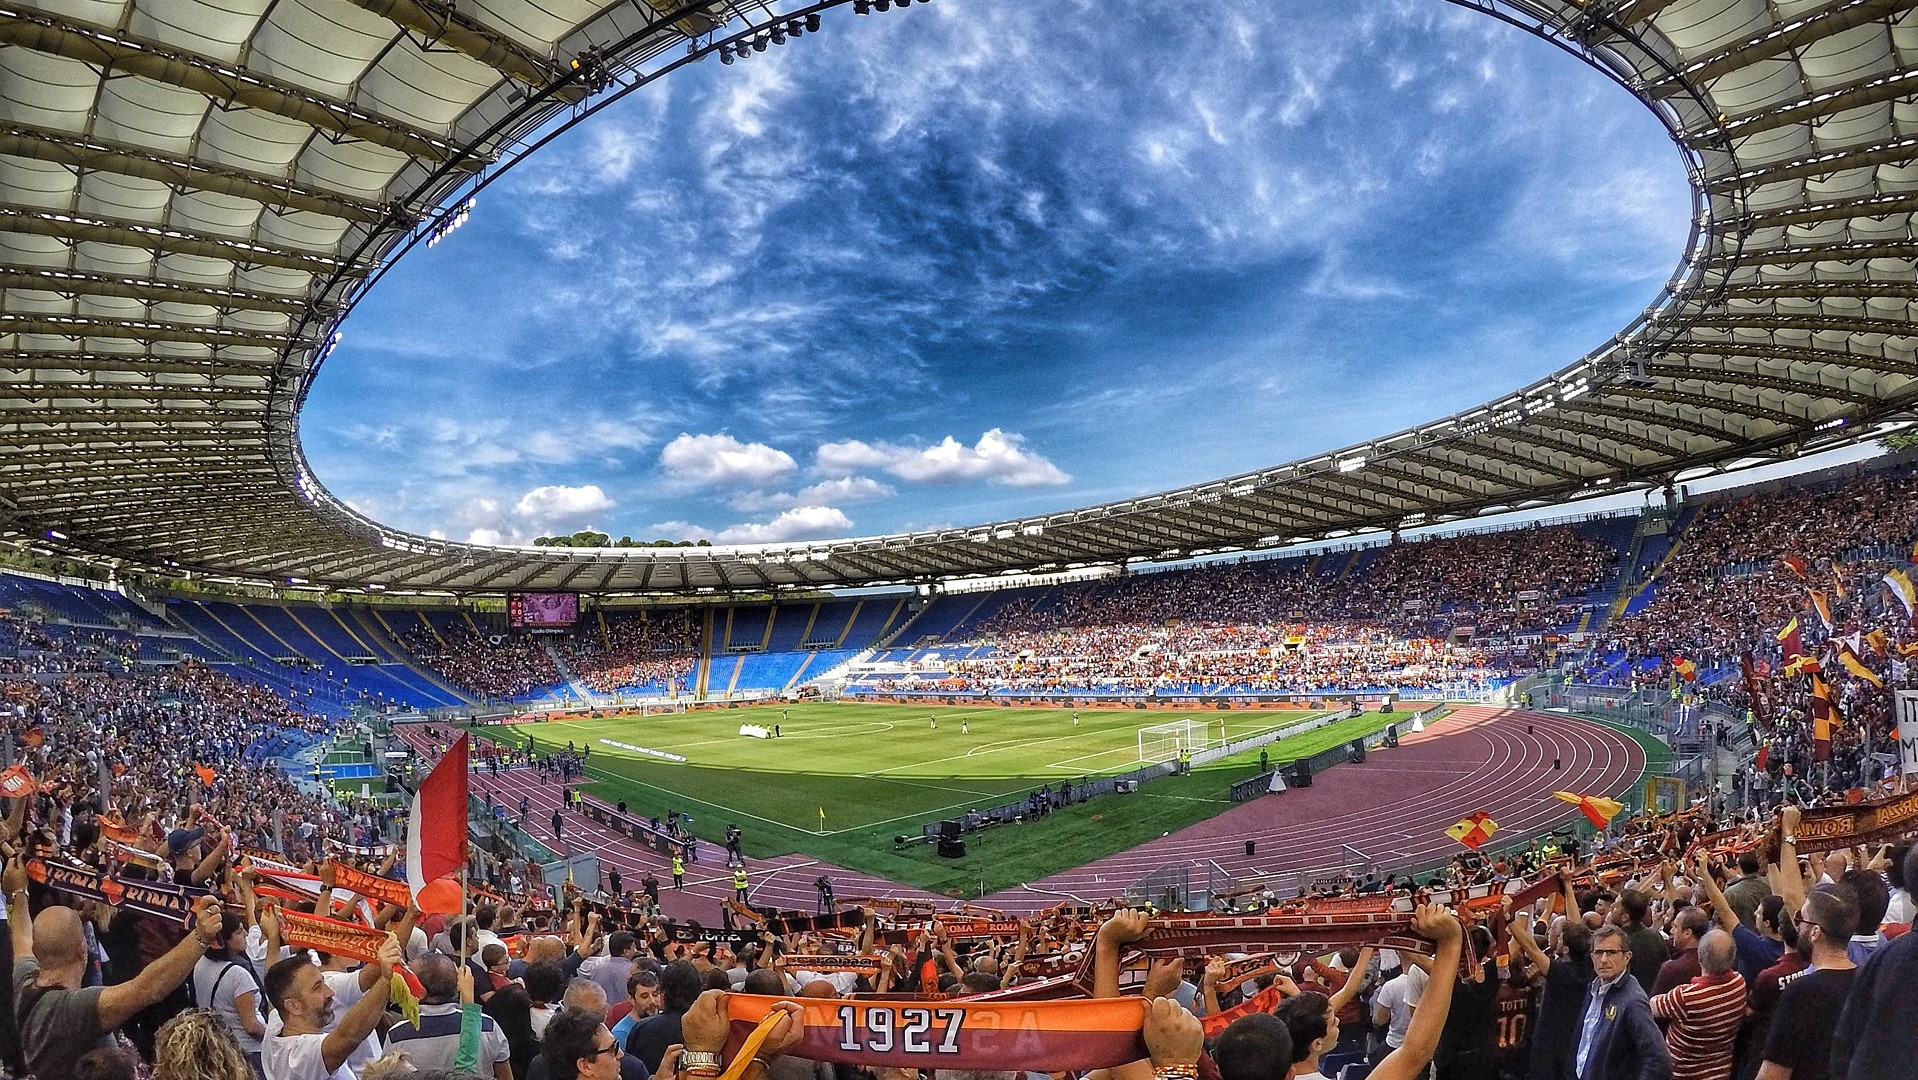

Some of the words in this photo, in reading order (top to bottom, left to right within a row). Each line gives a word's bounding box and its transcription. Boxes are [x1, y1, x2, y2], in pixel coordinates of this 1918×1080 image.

[125, 887, 180, 911] ROMA
[989, 923, 1020, 931] ROMA
[816, 957, 873, 967] roma
[1500, 998, 1527, 1012] TOTTI
[839, 1006, 966, 1053] 1927
[1497, 1013, 1527, 1048] 10
